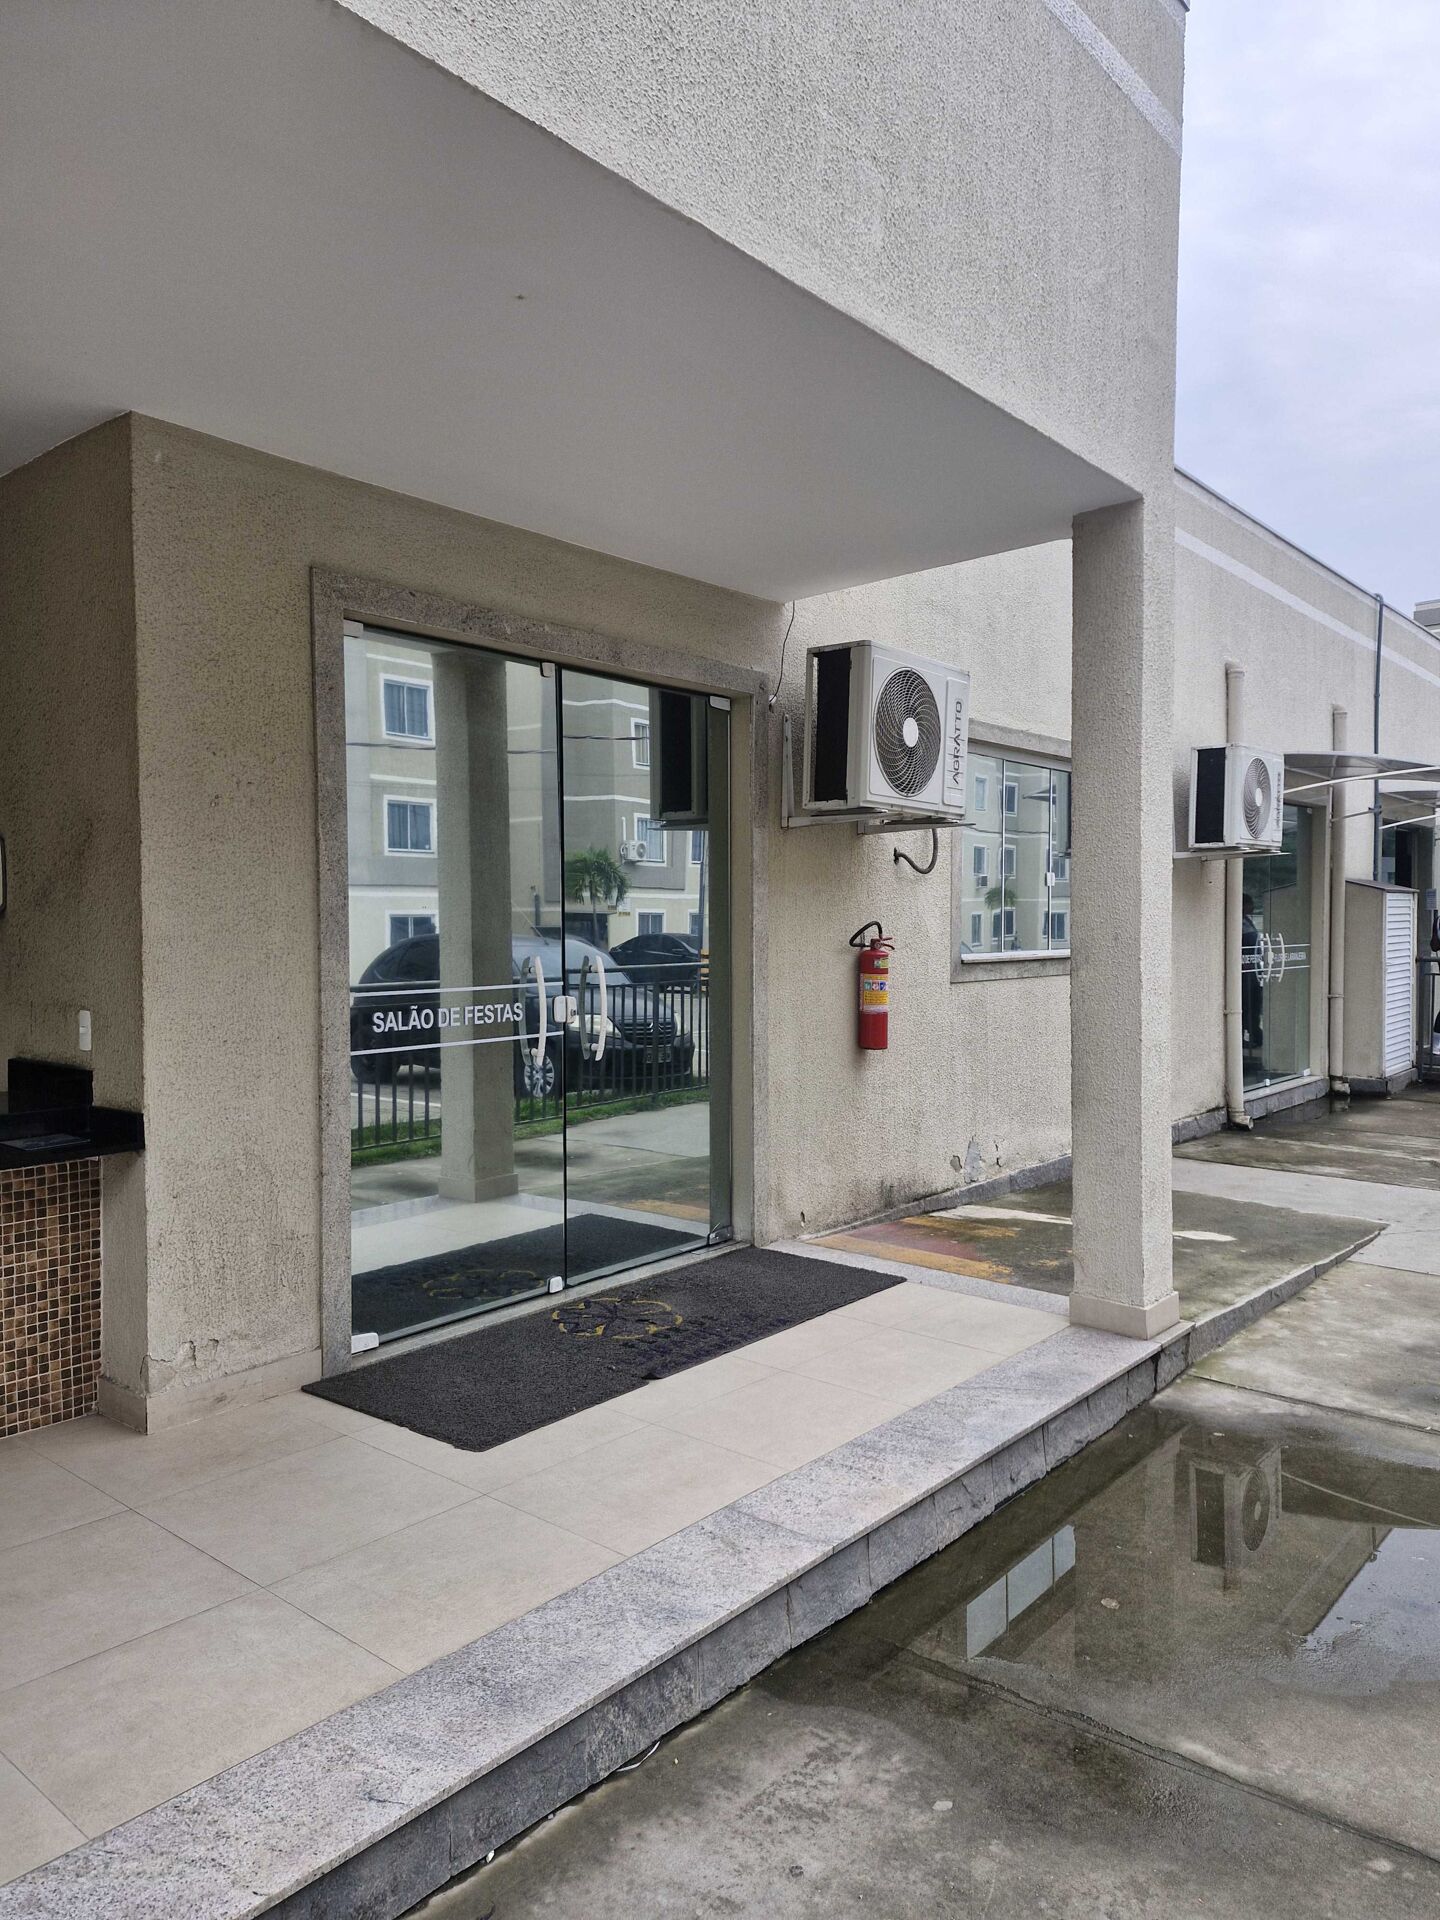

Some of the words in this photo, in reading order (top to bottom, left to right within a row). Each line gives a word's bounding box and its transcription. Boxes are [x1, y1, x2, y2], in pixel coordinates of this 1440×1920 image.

[953, 701, 962, 785] AGRATTO
[372, 1005, 434, 1033] SALÃO
[438, 1007, 461, 1028] DE
[464, 1002, 523, 1025] FESTAS
